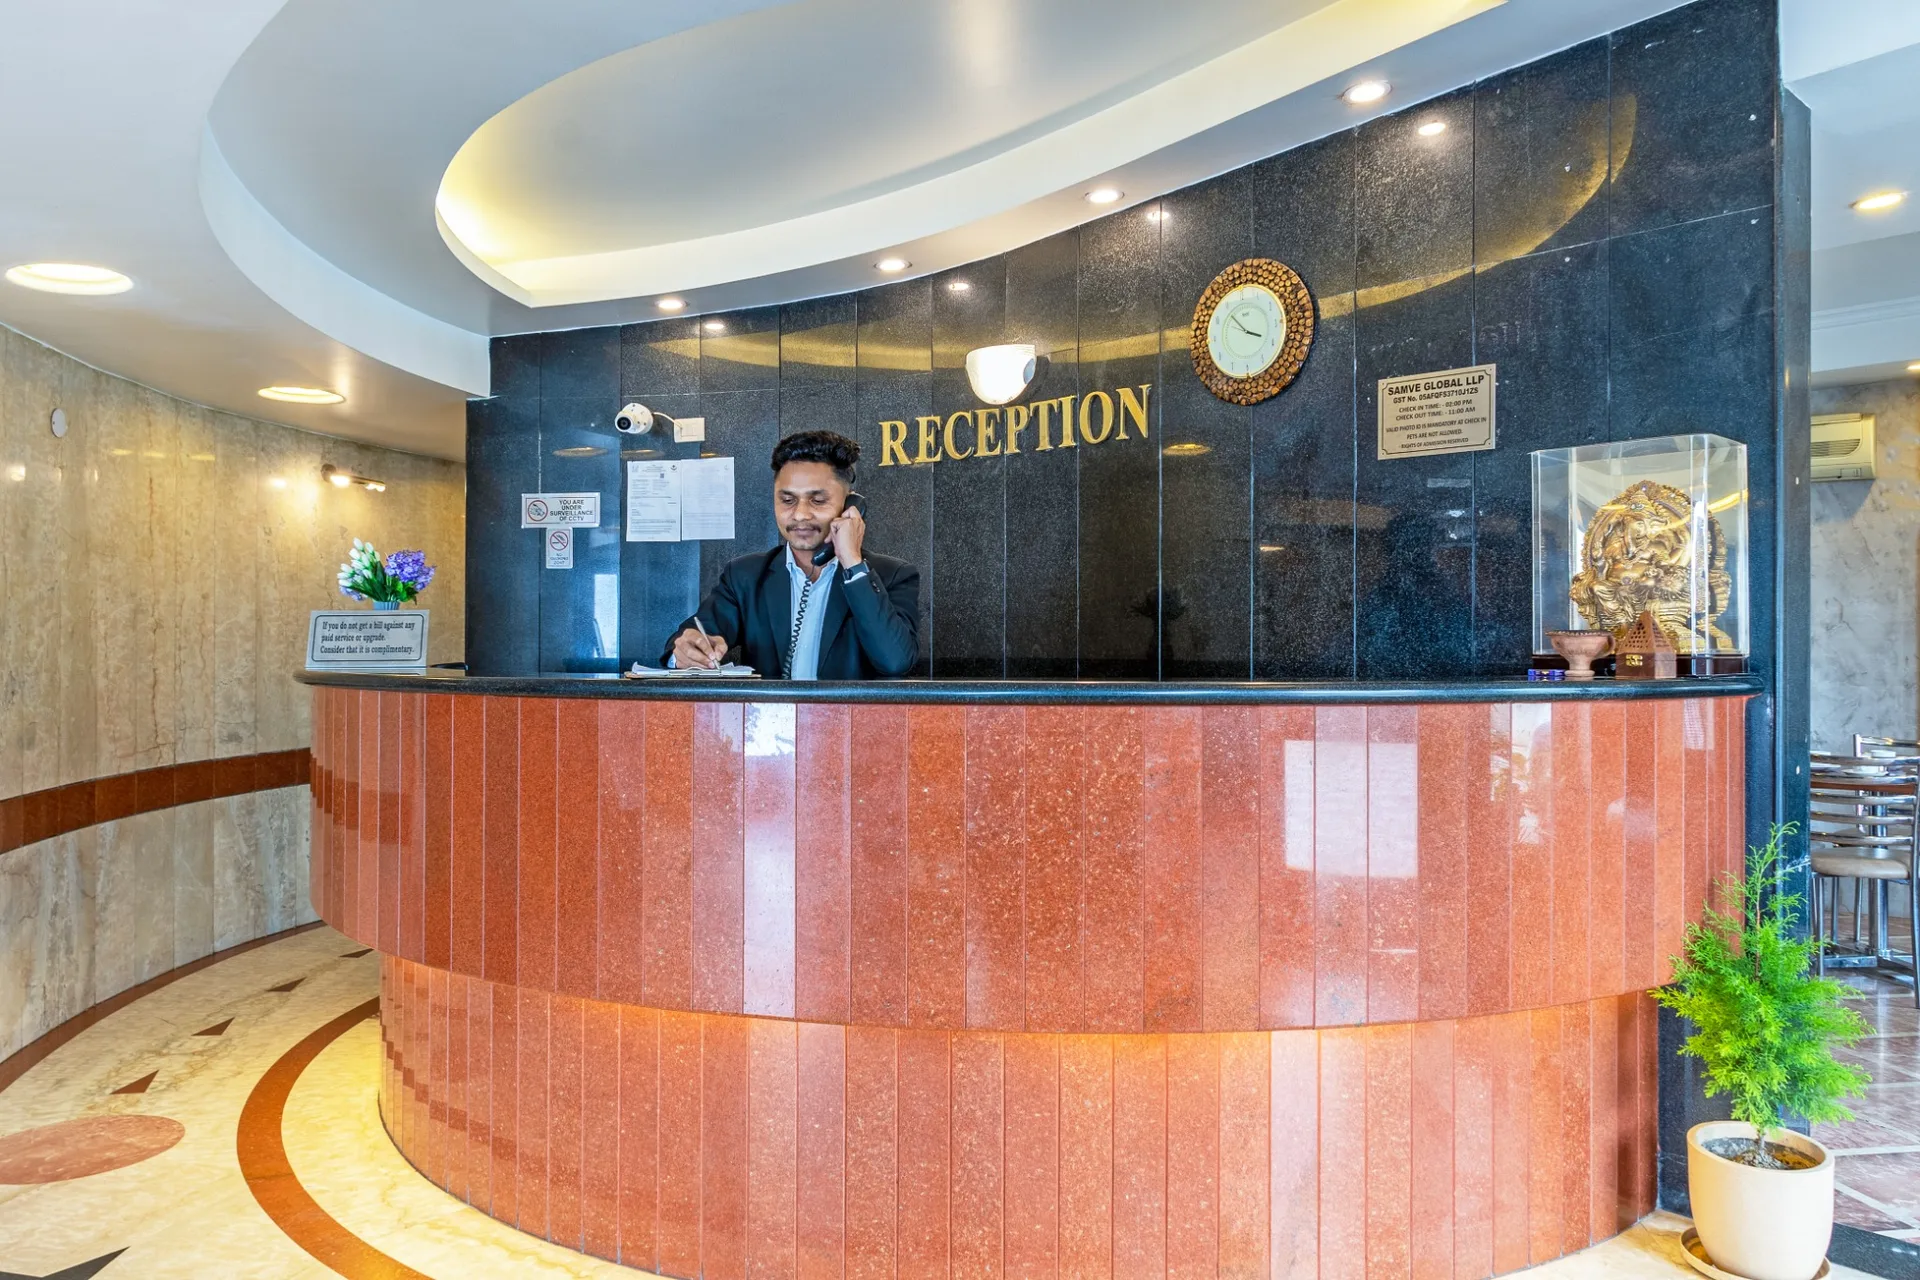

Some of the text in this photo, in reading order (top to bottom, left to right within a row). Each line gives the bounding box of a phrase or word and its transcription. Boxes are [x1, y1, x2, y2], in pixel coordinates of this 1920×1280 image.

[1388, 375, 1484, 395] SAMVE GLOBAL LLP
[879, 384, 1152, 467] RECEPTION
[358, 622, 368, 631] get
[384, 621, 403, 631] against
[321, 634, 333, 643] paid
[363, 634, 385, 643] upgrade.
[371, 645, 414, 655] complimentary.
